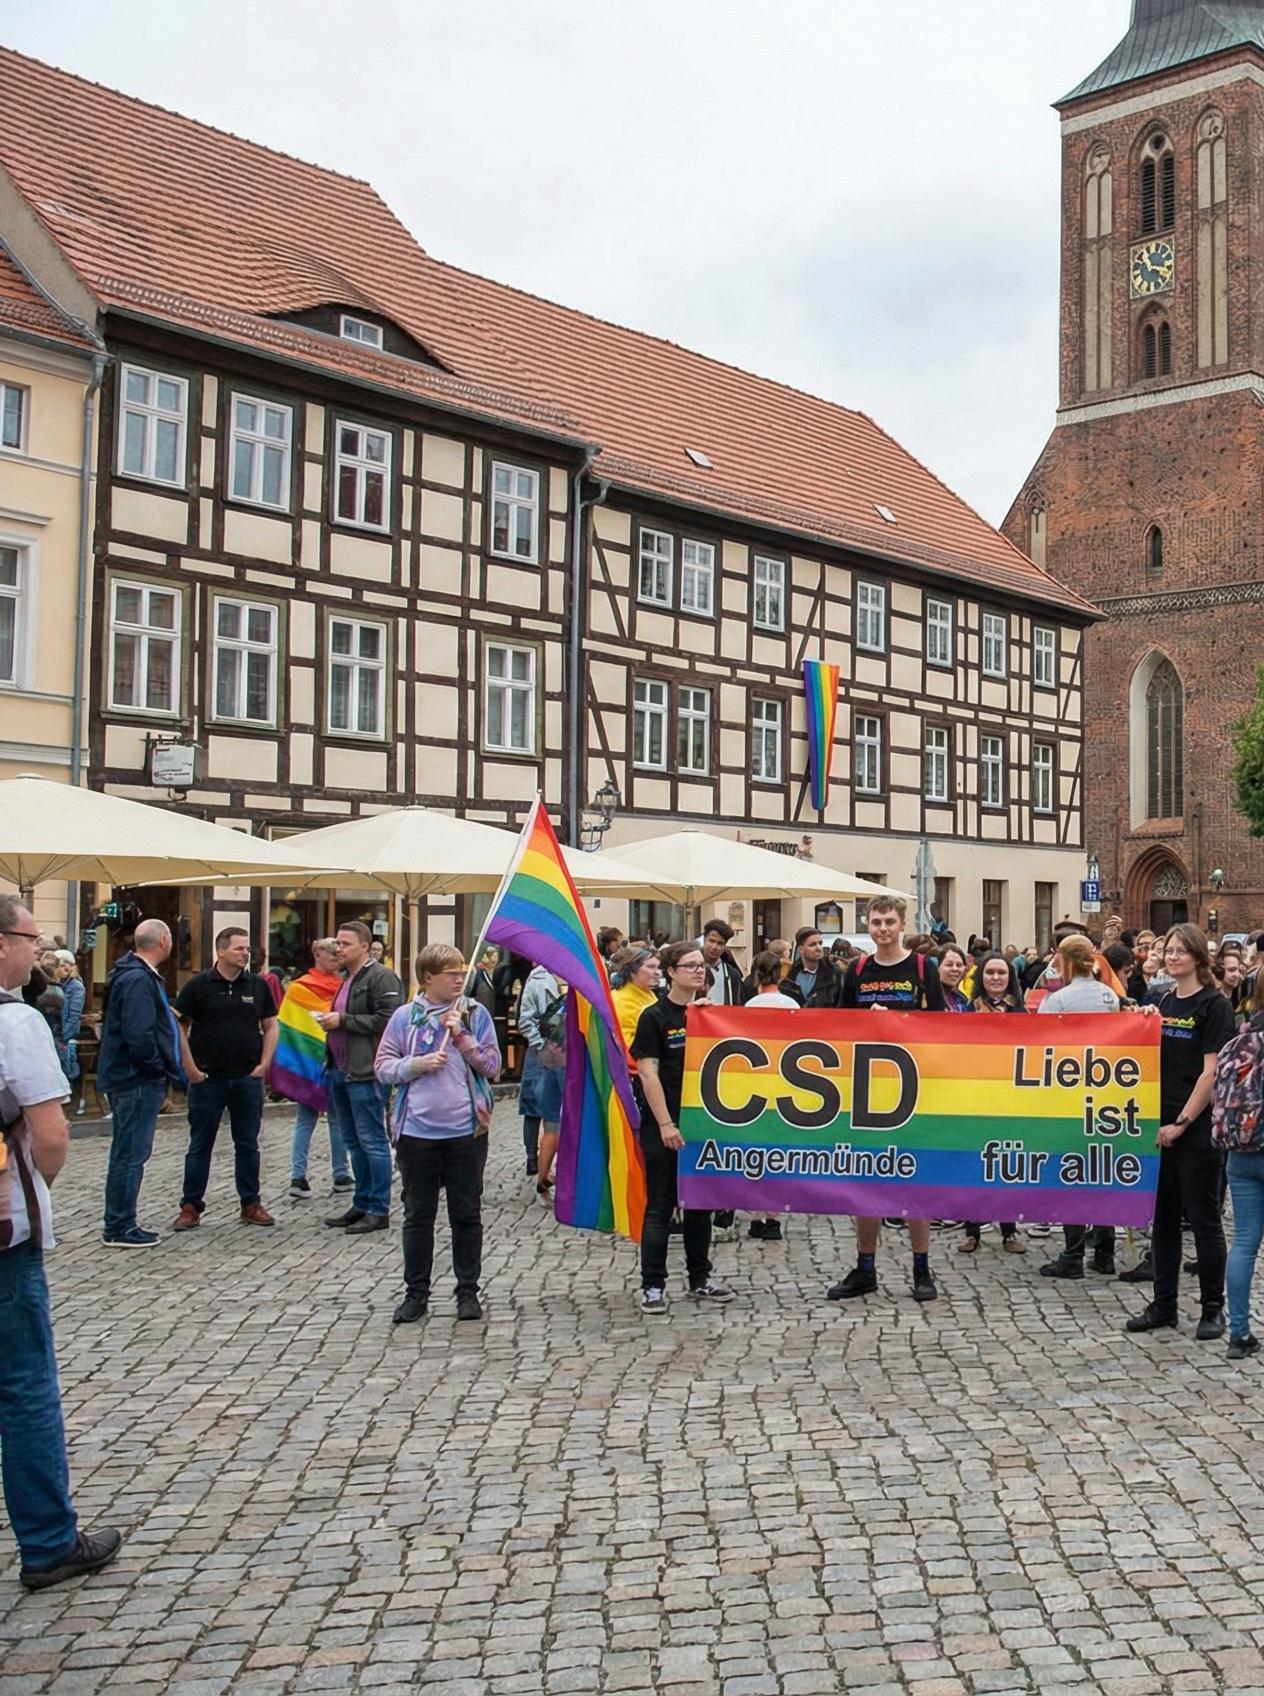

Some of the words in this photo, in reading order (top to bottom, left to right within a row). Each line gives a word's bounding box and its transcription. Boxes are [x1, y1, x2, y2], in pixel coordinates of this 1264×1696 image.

[700, 1037, 919, 1130] CSD
[1014, 1046, 1141, 1088] Liebe
[1084, 1095, 1141, 1136] ist
[696, 1139, 917, 1180] Angermünde
[981, 1141, 1049, 1183] für
[1060, 1143, 1141, 1185] alle
